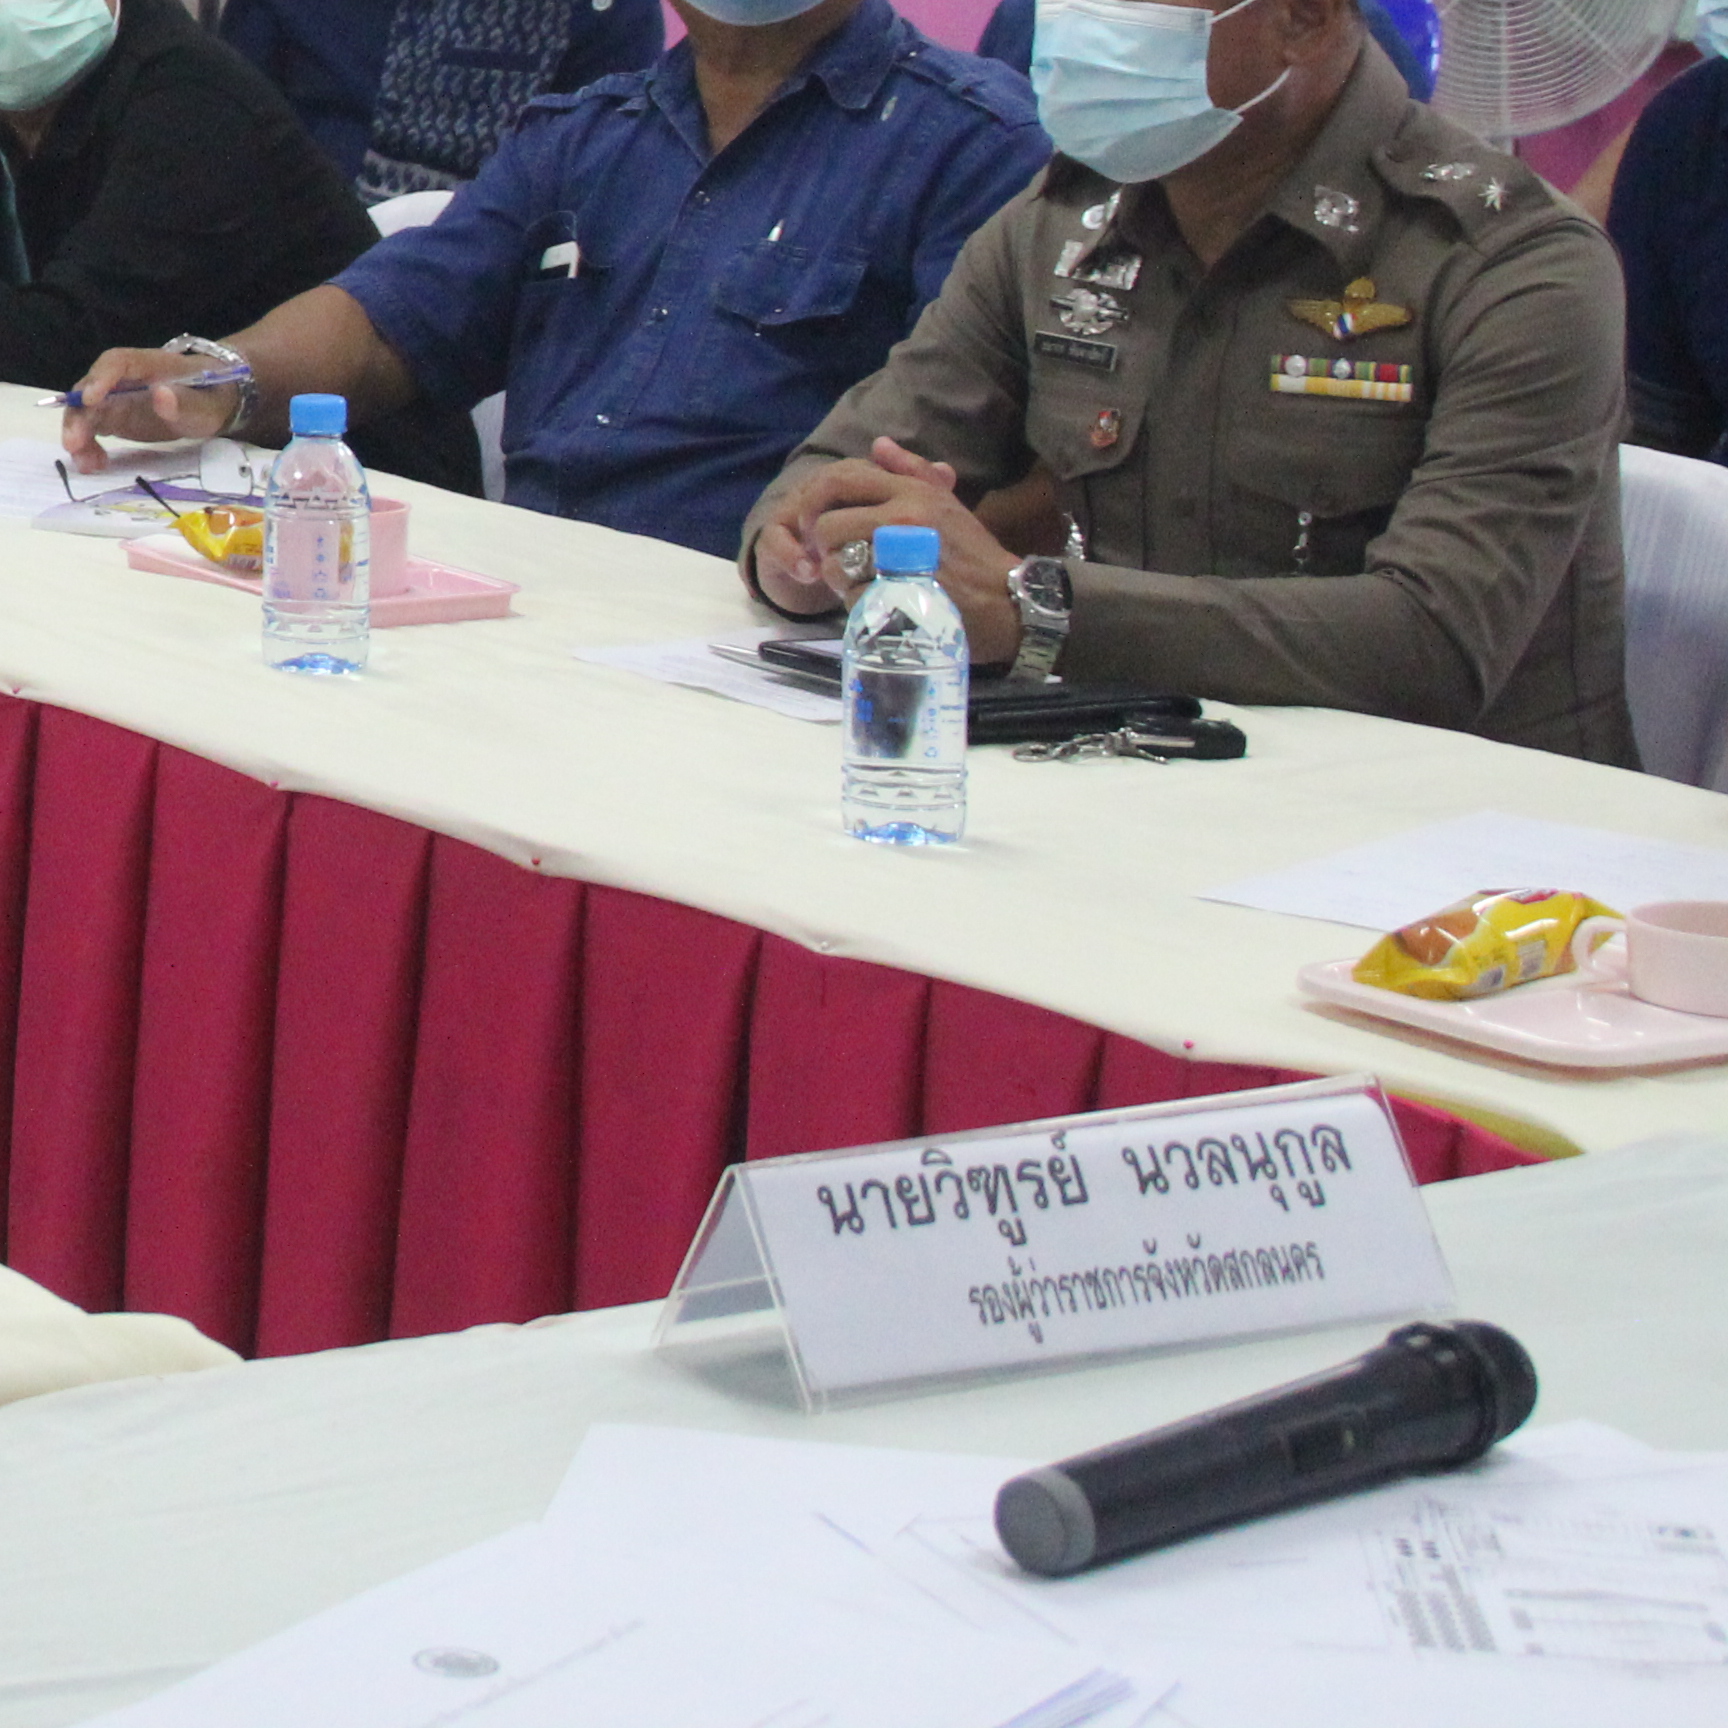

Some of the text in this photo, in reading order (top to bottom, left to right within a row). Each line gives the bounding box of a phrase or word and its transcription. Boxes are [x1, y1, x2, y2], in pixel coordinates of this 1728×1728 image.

[817, 1119, 1352, 1246] นายวิฑูรย์ นวลนุกูล
[968, 1235, 1328, 1344] รองผู้ว่าราชการจังหวัดสกลนคร
